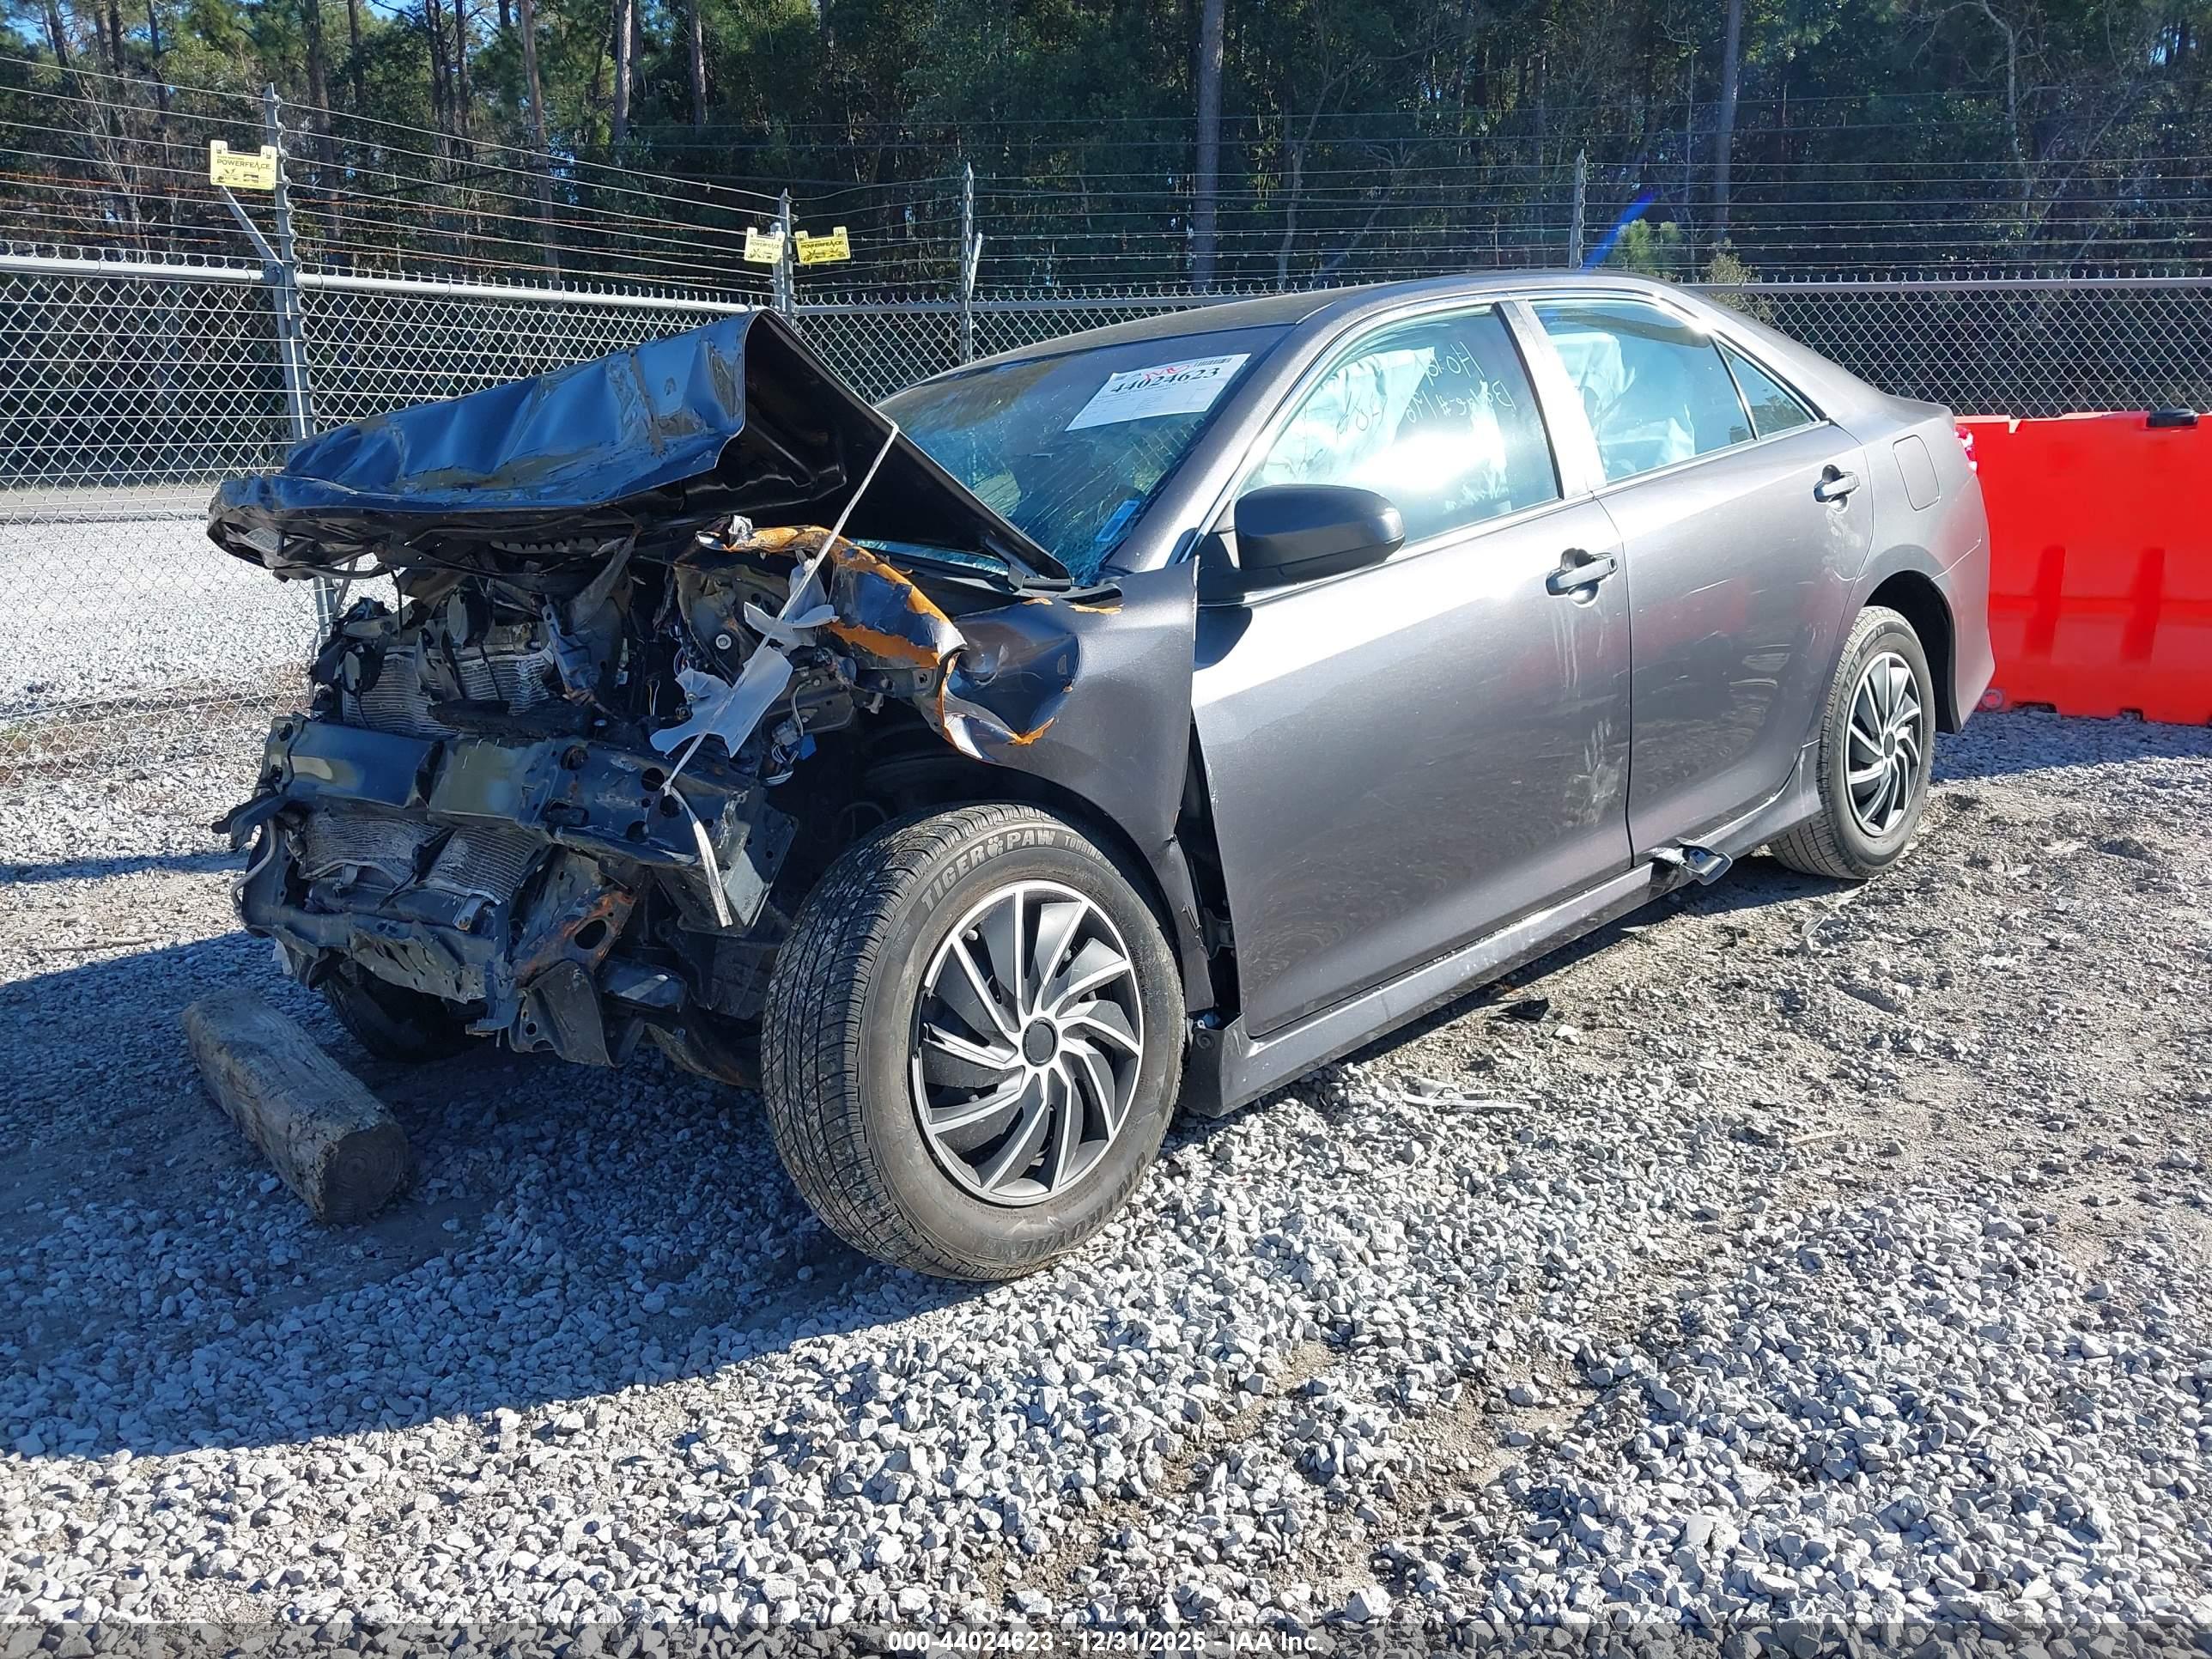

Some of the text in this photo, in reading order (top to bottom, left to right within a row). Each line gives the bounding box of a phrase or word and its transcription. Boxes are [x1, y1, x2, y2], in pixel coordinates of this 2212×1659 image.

[1111, 368, 1220, 392] 44024623
[921, 845, 986, 912] TIGER
[1006, 830, 1056, 850] PAW
[1064, 835, 1103, 860] TOURING
